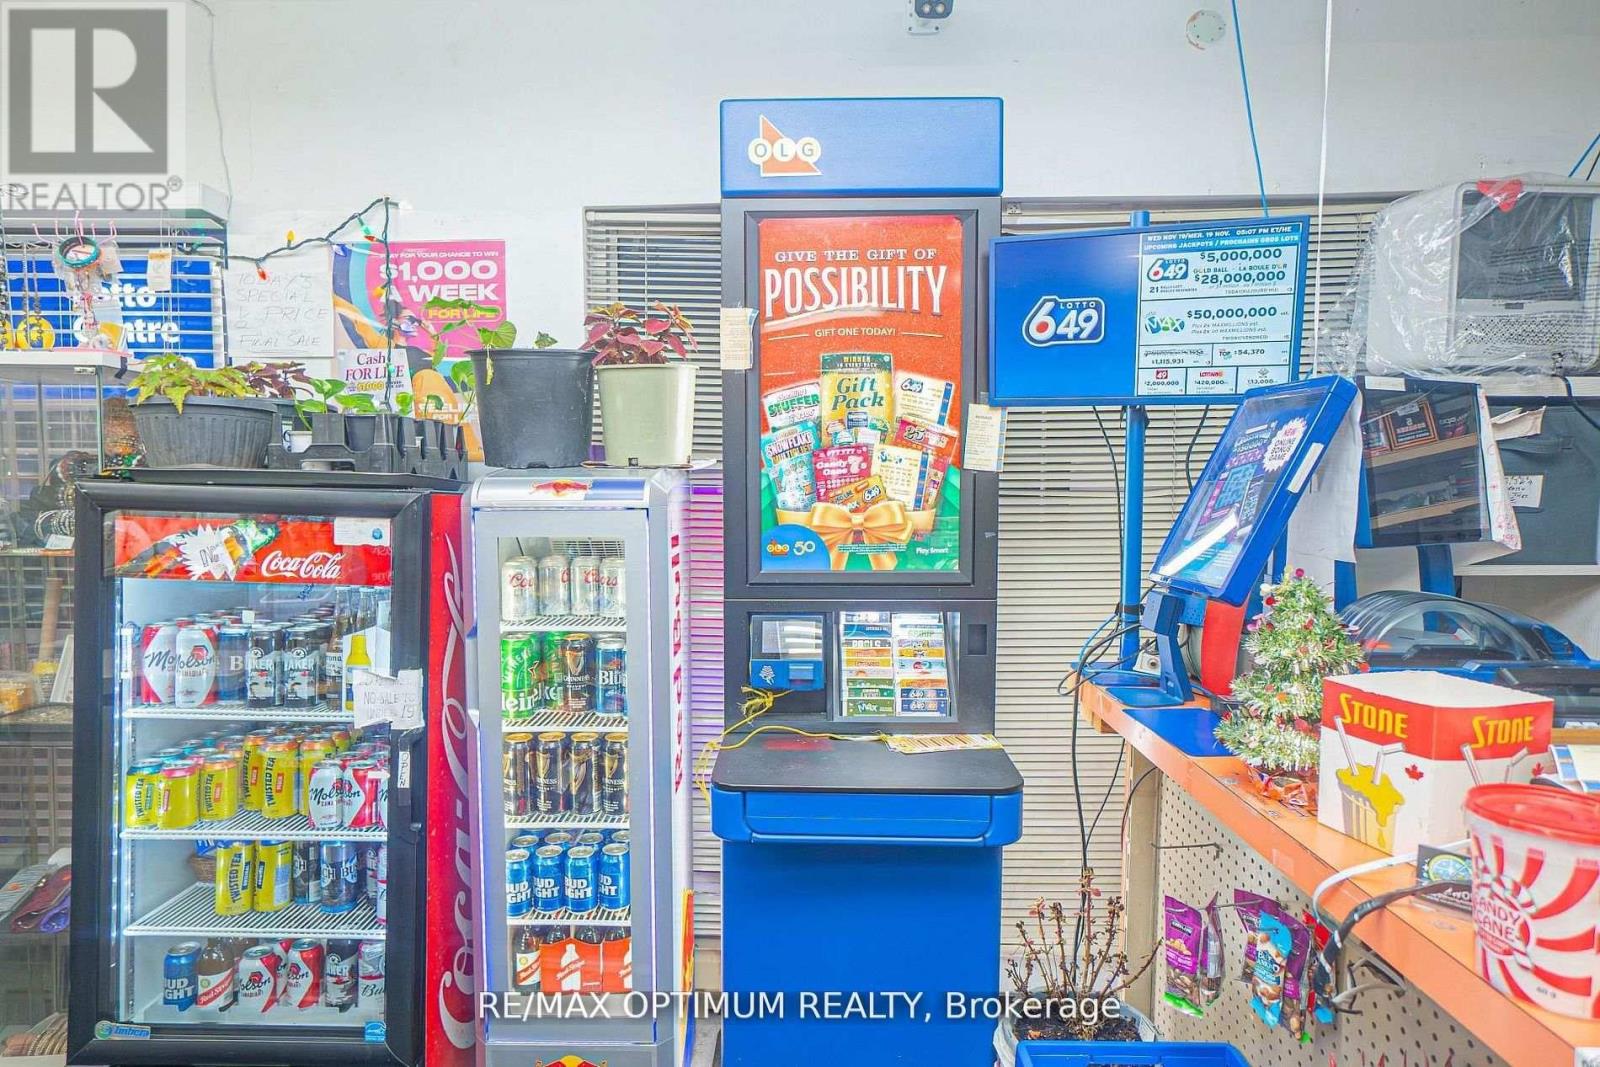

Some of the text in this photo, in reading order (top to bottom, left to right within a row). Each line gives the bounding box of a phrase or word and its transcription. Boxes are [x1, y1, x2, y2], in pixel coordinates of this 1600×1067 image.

[751, 140, 818, 161] OLG
[775, 248, 937, 263] GIVE THE GIFT OF
[1200, 248, 1282, 263] $5,000,000
[379, 260, 499, 283] $1,000
[1195, 271, 1286, 285] $28,000,000
[408, 283, 499, 302] WEEK
[764, 265, 948, 319] POSSIBILITY
[428, 307, 461, 320] FOR
[1059, 301, 1096, 309] LOTTO
[1187, 306, 1277, 321] $50,000,000
[814, 327, 896, 338] GIFT ONE TODAY!
[357, 351, 386, 366] Cash
[346, 364, 405, 381] FOR LIE
[837, 376, 877, 394] Gift
[768, 393, 820, 418] STUFFER
[831, 392, 884, 411] Pack
[261, 550, 347, 579] Coca-Cola
[265, 757, 276, 806] TWISTED TEA
[229, 853, 243, 902] TWISTED TEA
[507, 890, 532, 904] GHT
